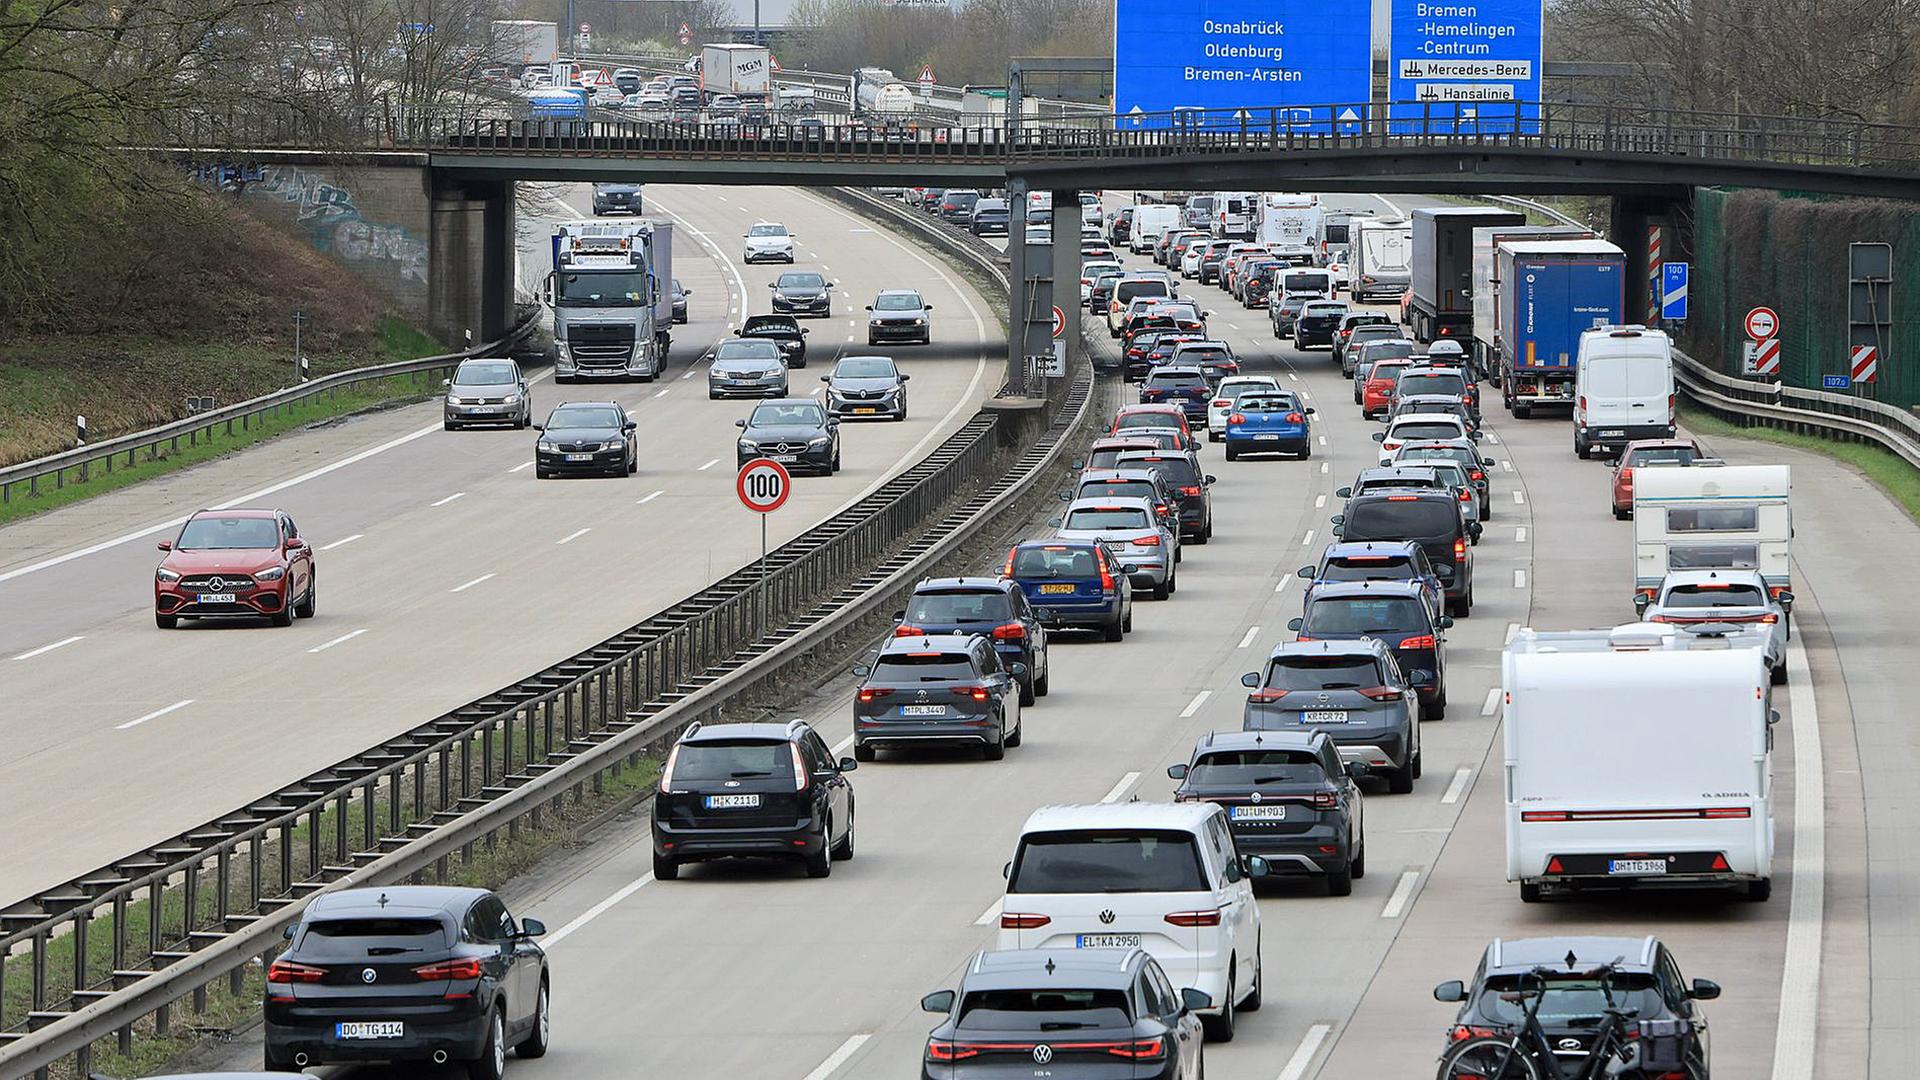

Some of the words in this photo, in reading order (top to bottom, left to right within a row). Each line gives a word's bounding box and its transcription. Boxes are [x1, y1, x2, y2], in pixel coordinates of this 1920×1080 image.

[1417, 3, 1477, 17] Bremen
[1203, 19, 1284, 35] Osnabrück
[1416, 22, 1515, 39] -Hemelingen
[1205, 44, 1283, 61] Oldenburg
[1416, 40, 1489, 54] -Centrum
[736, 60, 762, 73] MGM
[1428, 63, 1527, 76] Mercedes-Benz
[1184, 67, 1302, 81] Bremen-Arsten
[1443, 88, 1510, 100] Hansalinie
[1668, 265, 1683, 274] 100
[747, 474, 779, 497] 100
[927, 706, 945, 714] 3449
[1307, 712, 1318, 721] KR
[1334, 712, 1345, 720] 72
[734, 795, 758, 804] 2118
[1237, 807, 1249, 817] DU
[1254, 807, 1266, 816] UH
[1267, 806, 1284, 816] 903
[1615, 862, 1626, 871] OH
[1632, 862, 1643, 871] TG
[1083, 936, 1095, 947] EL
[1101, 936, 1114, 947] KA
[1115, 935, 1139, 947] 2950
[343, 1024, 358, 1036] DO
[365, 1024, 379, 1035] TG
[381, 1023, 402, 1035] 114
